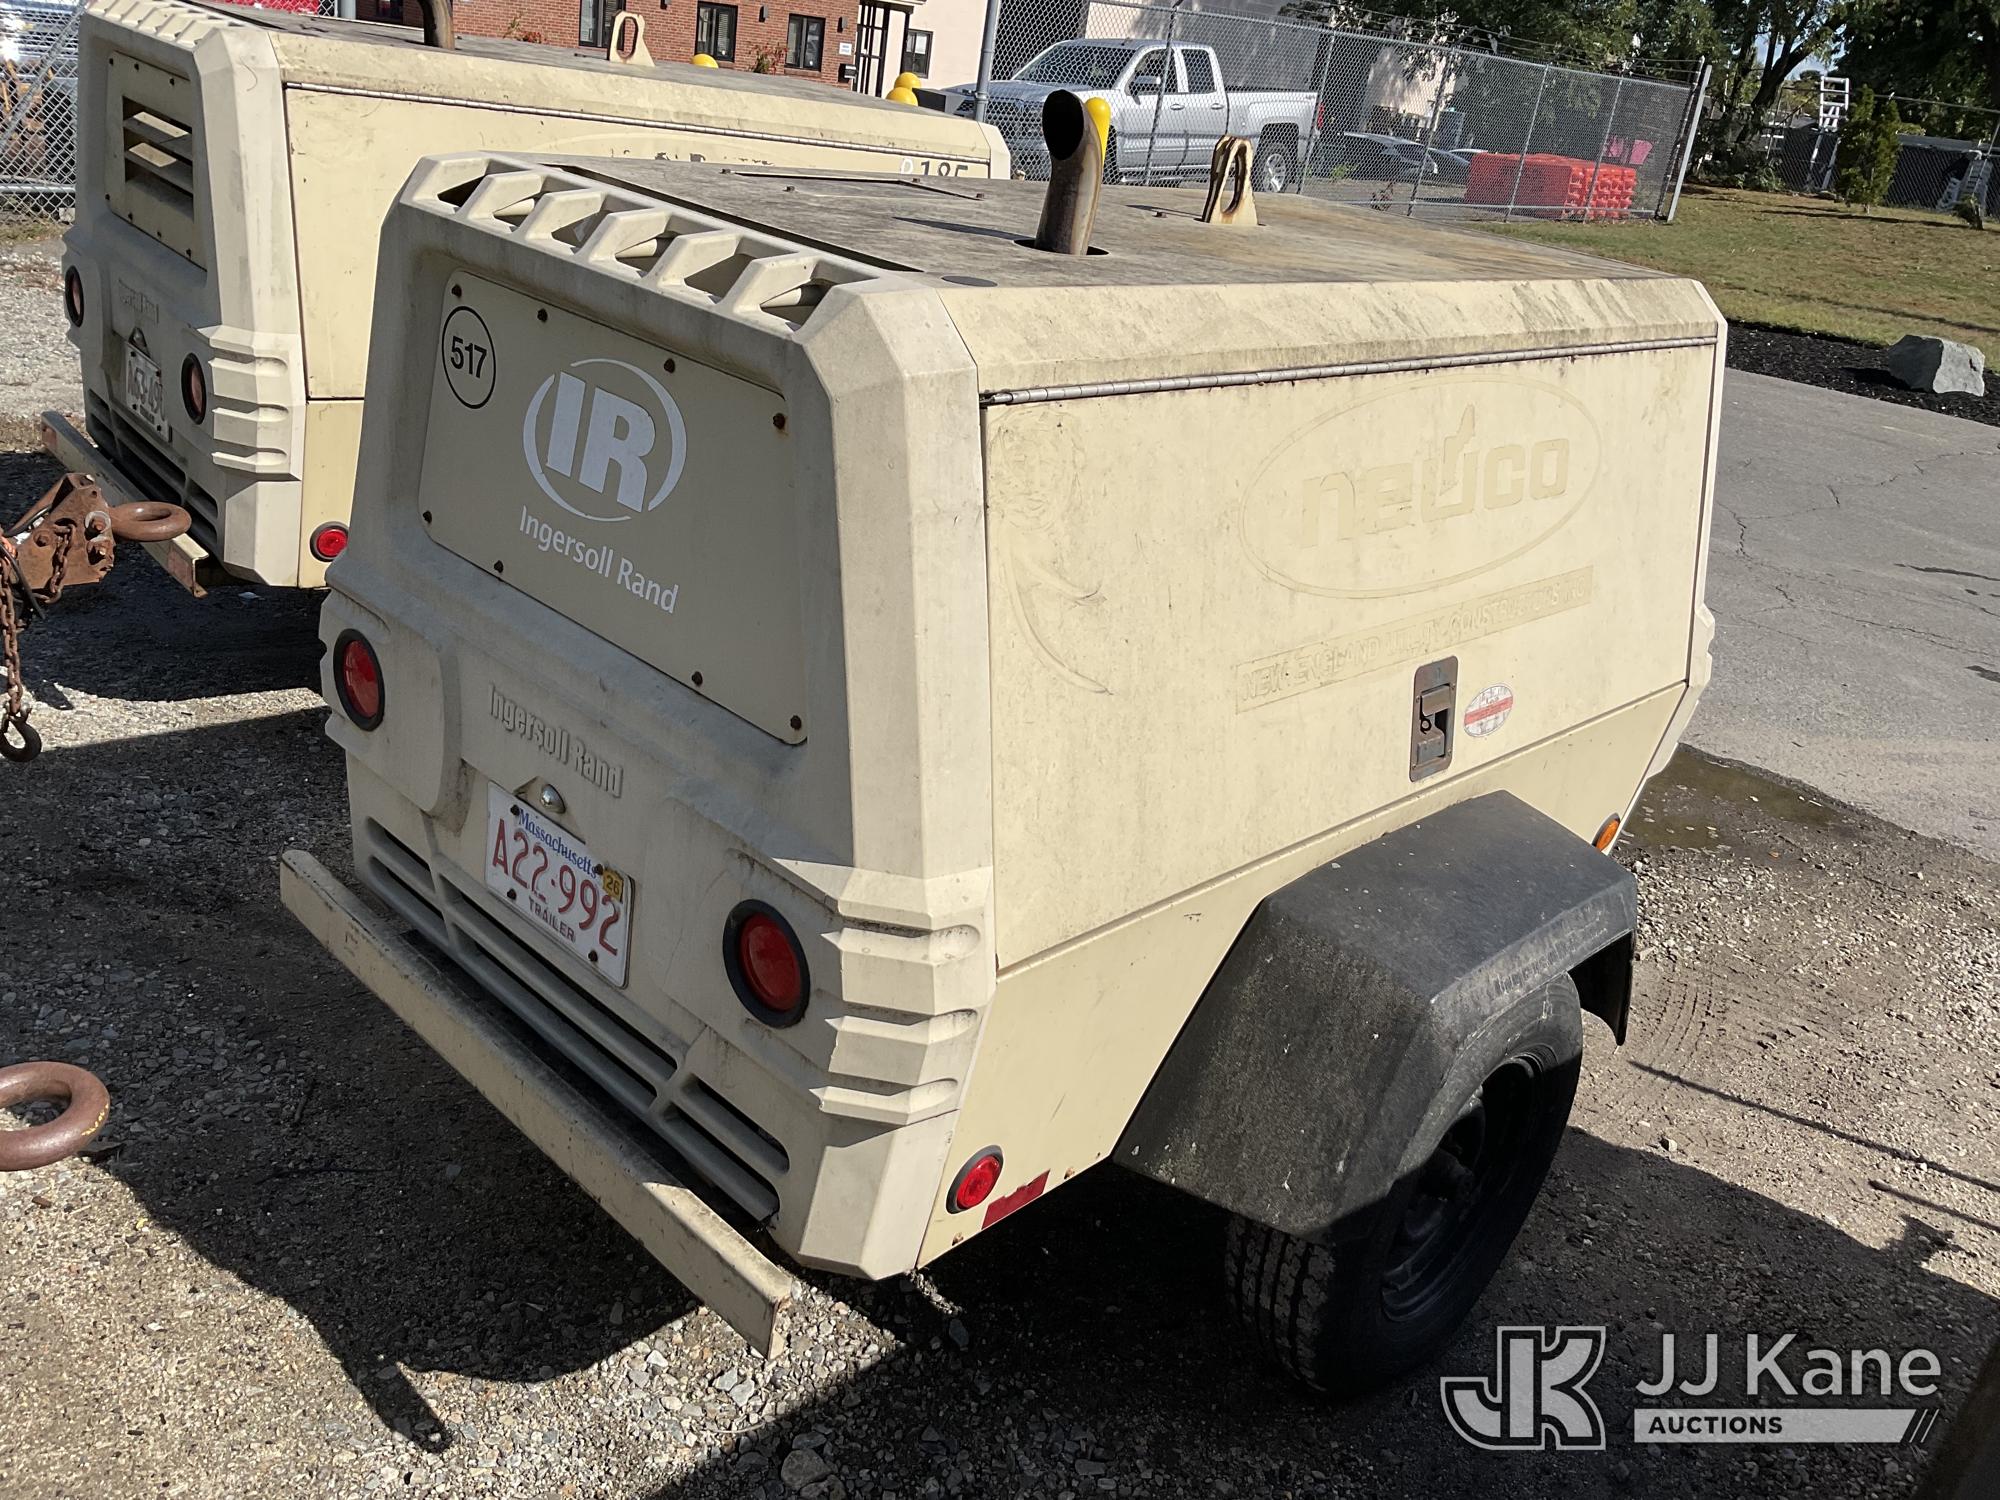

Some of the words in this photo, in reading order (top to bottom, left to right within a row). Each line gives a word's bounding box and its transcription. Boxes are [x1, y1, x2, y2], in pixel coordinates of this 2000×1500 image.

[450, 336, 487, 379] 517
[546, 371, 656, 513] IR
[519, 505, 614, 578] Ingersoll
[616, 556, 680, 614] Rand
[488, 682, 570, 765] Ingersoll
[573, 734, 623, 798] Rand
[518, 808, 598, 880] Massachusetts
[528, 895, 576, 943] TRAILER
